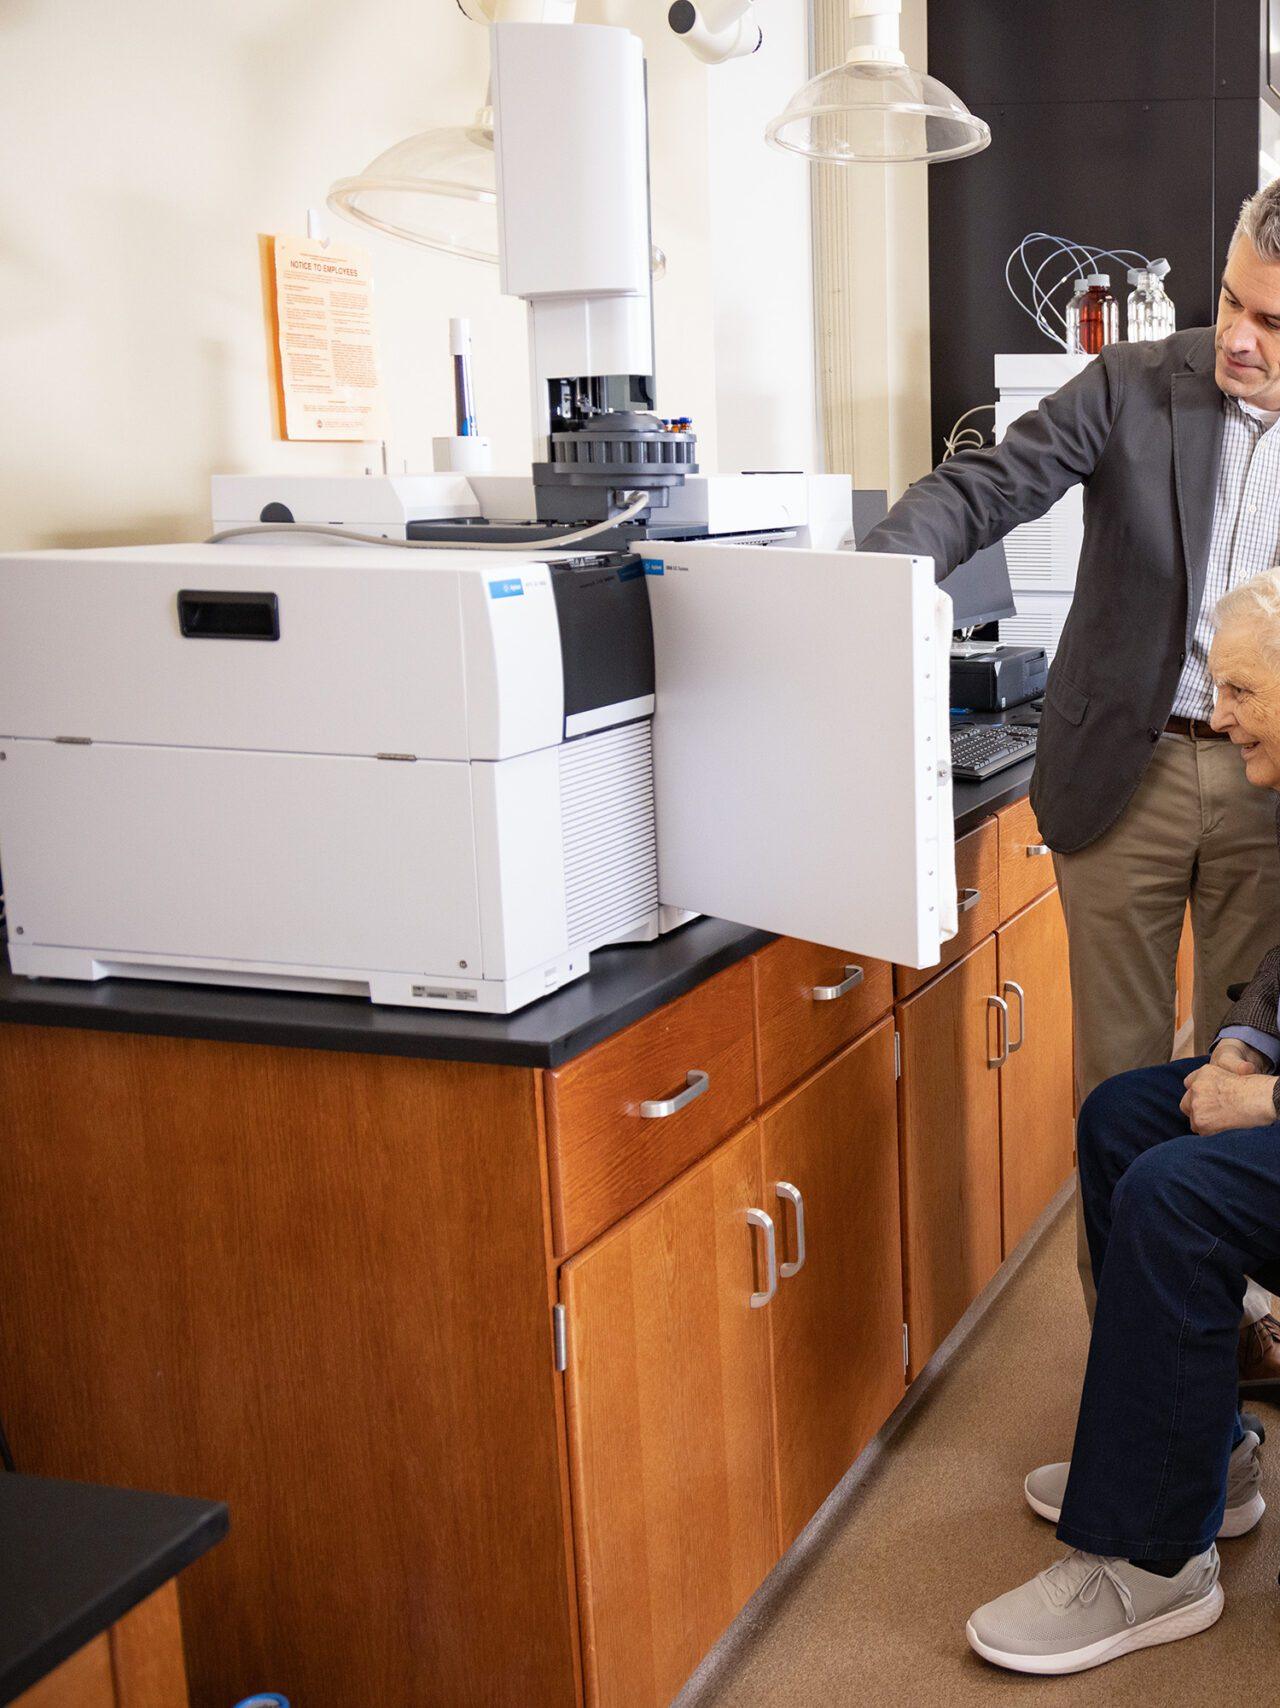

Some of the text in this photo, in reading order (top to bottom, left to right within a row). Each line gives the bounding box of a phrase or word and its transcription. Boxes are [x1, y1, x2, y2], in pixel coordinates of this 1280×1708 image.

[290, 260, 358, 277] NOTICE TO EMPLOYEES
